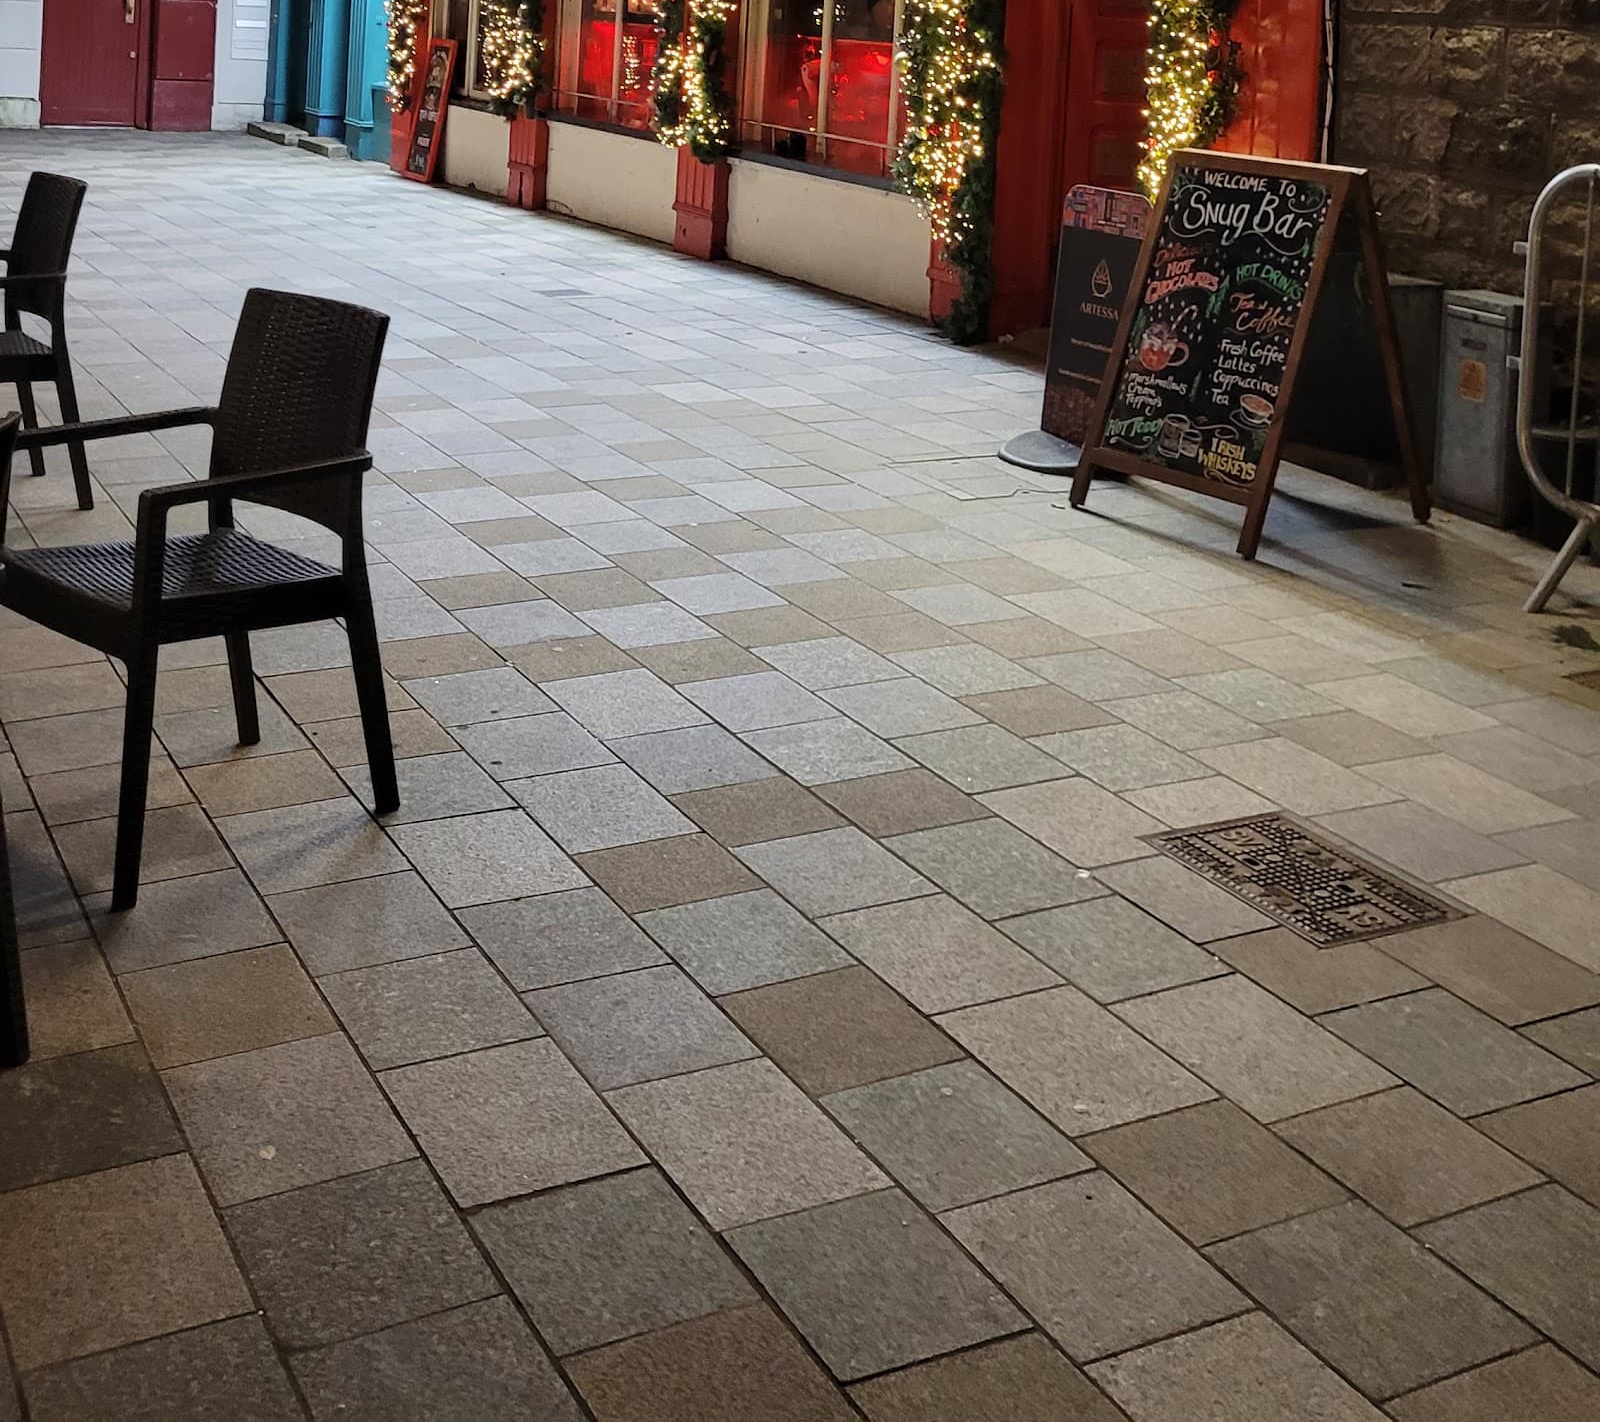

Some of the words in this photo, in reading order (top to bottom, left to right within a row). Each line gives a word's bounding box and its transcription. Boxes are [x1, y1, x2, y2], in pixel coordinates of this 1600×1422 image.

[1204, 170, 1268, 192] WELCOME
[1279, 180, 1297, 198] TO
[1252, 191, 1313, 239] Bar
[1165, 258, 1196, 278] HOT
[1236, 263, 1260, 282] HOT
[1260, 265, 1304, 300] DRINKS
[1079, 301, 1119, 321] ARTESSA
[1235, 306, 1295, 334] Coffee
[1218, 354, 1257, 374] Lattes
[1220, 338, 1248, 356] Fresh
[1249, 340, 1285, 366] Coffee
[1211, 388, 1229, 406] Tea
[1213, 369, 1279, 398] Cappuccinos
[1106, 418, 1128, 438] HOT
[1211, 437, 1246, 461] IRISH
[1198, 448, 1257, 481] WHISKEYS
